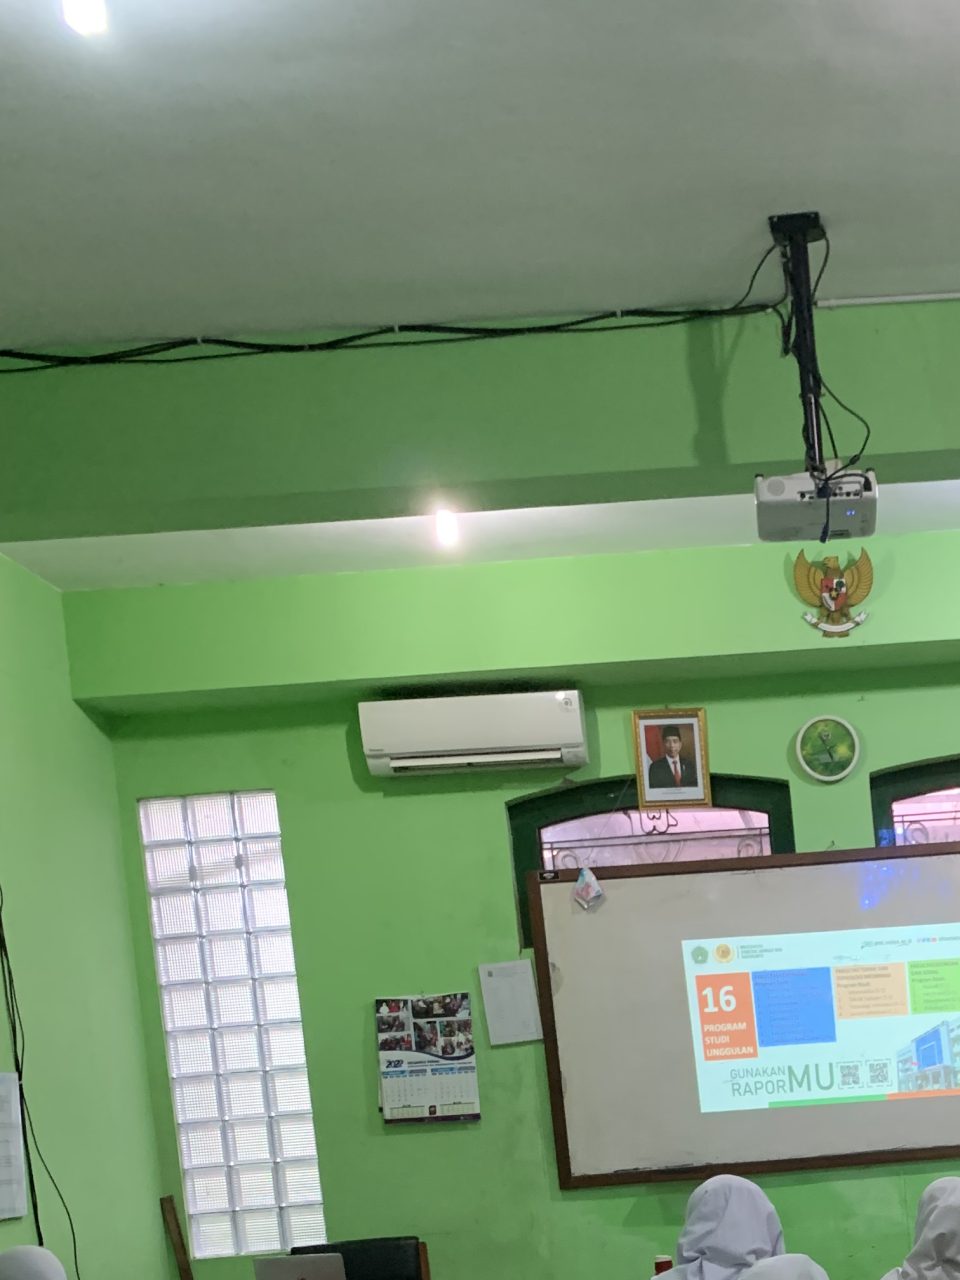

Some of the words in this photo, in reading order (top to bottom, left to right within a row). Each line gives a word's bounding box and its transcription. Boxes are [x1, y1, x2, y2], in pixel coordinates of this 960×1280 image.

[702, 985, 737, 1013] 16
[704, 1022, 747, 1033] PROGRAM
[705, 1035, 730, 1045] STUDI
[706, 1046, 754, 1057] UNGGULAN
[730, 1064, 786, 1080] GUNAKAN
[731, 1080, 788, 1097] RAPOR
[787, 1062, 835, 1093] MU
